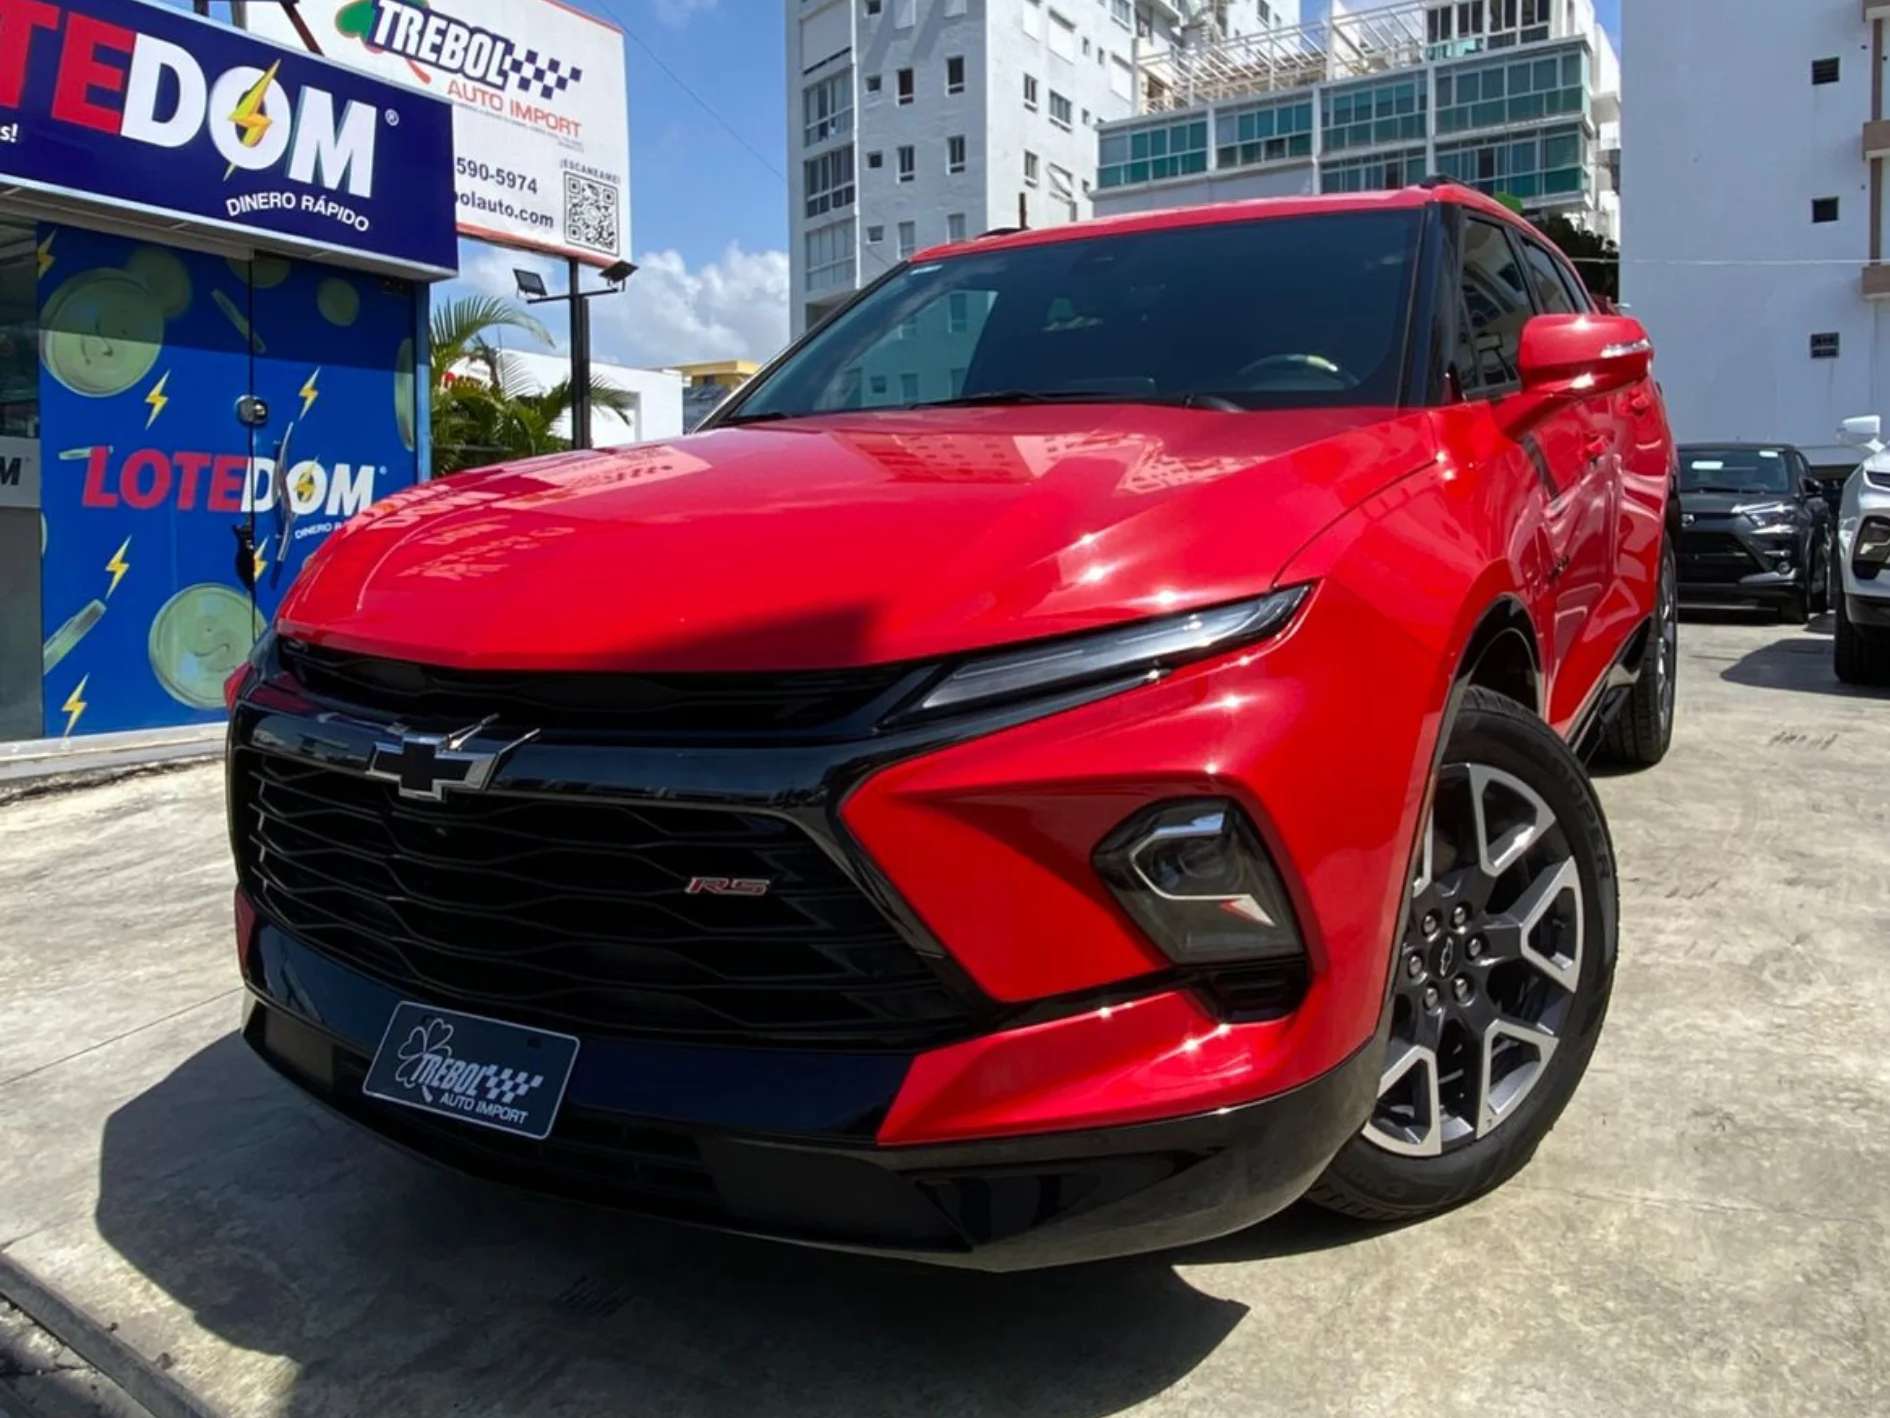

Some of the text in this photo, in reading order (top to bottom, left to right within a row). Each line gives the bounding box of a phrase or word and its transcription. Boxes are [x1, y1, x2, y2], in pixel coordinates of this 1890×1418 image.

[372, 0, 510, 90] TREBOL
[447, 79, 504, 112] AUTO
[510, 98, 582, 137] IMPORT
[456, 156, 538, 195] 590-5974
[226, 192, 370, 232] DINERO RÁPIDO
[81, 446, 375, 516] LOTEDOM
[685, 876, 770, 896] RS
[411, 1052, 489, 1097] TREBOL
[440, 1091, 530, 1125] AUTO IMPORT
